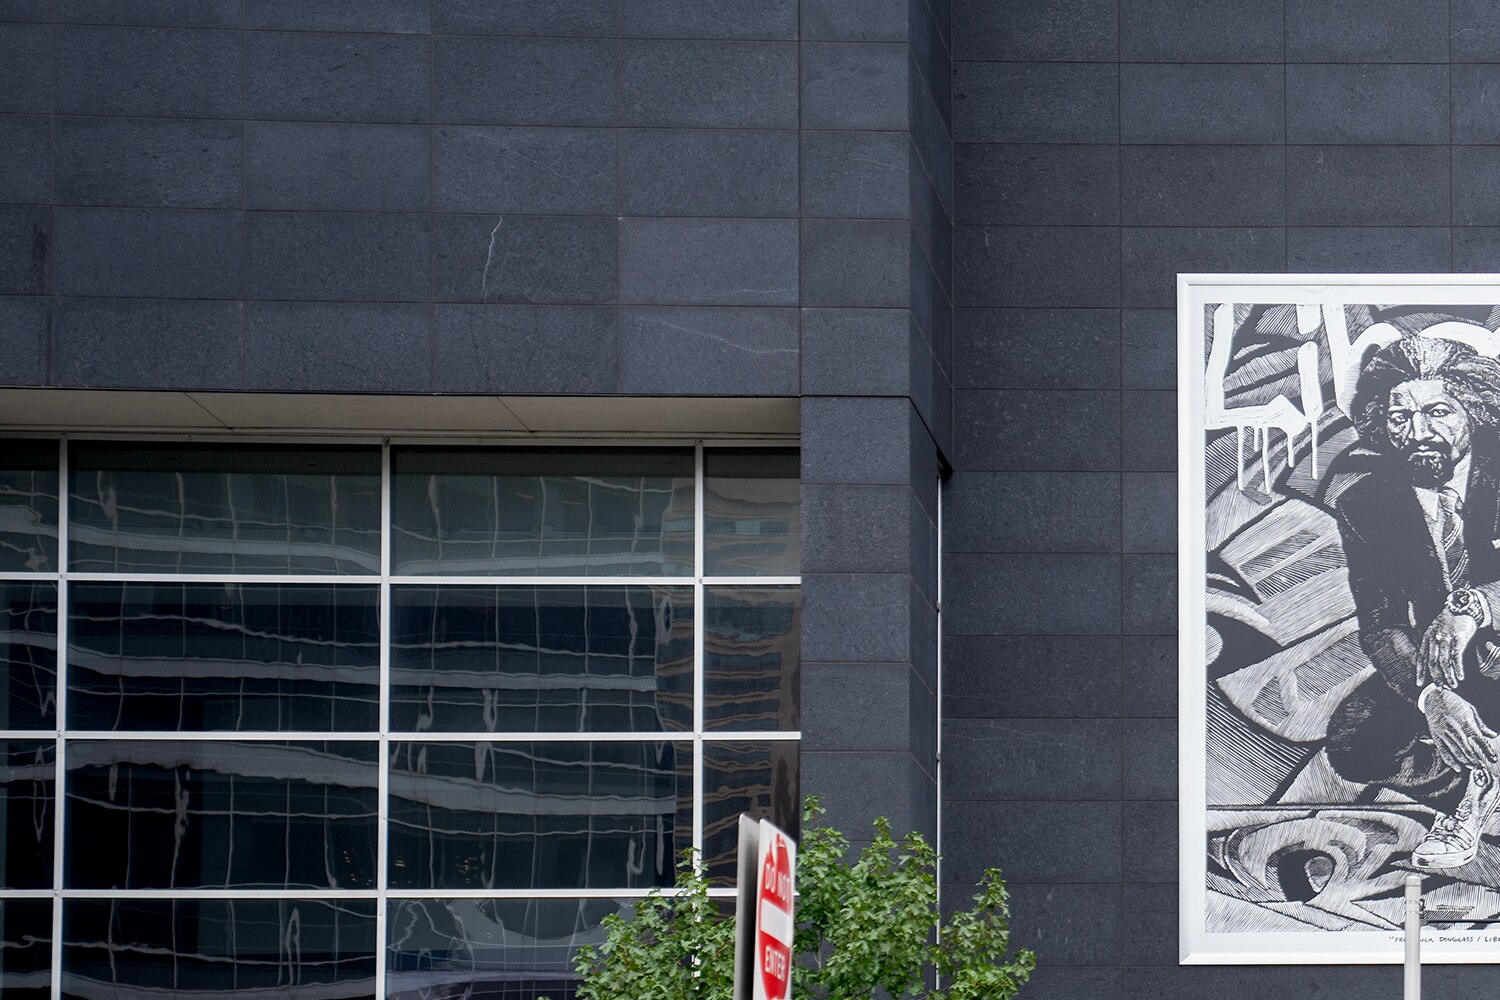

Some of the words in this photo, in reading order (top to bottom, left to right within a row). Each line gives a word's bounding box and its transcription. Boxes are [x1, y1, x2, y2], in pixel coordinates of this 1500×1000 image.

[765, 863, 776, 893] DO
[777, 871, 791, 903] NOT
[764, 945, 785, 982] ENTER
